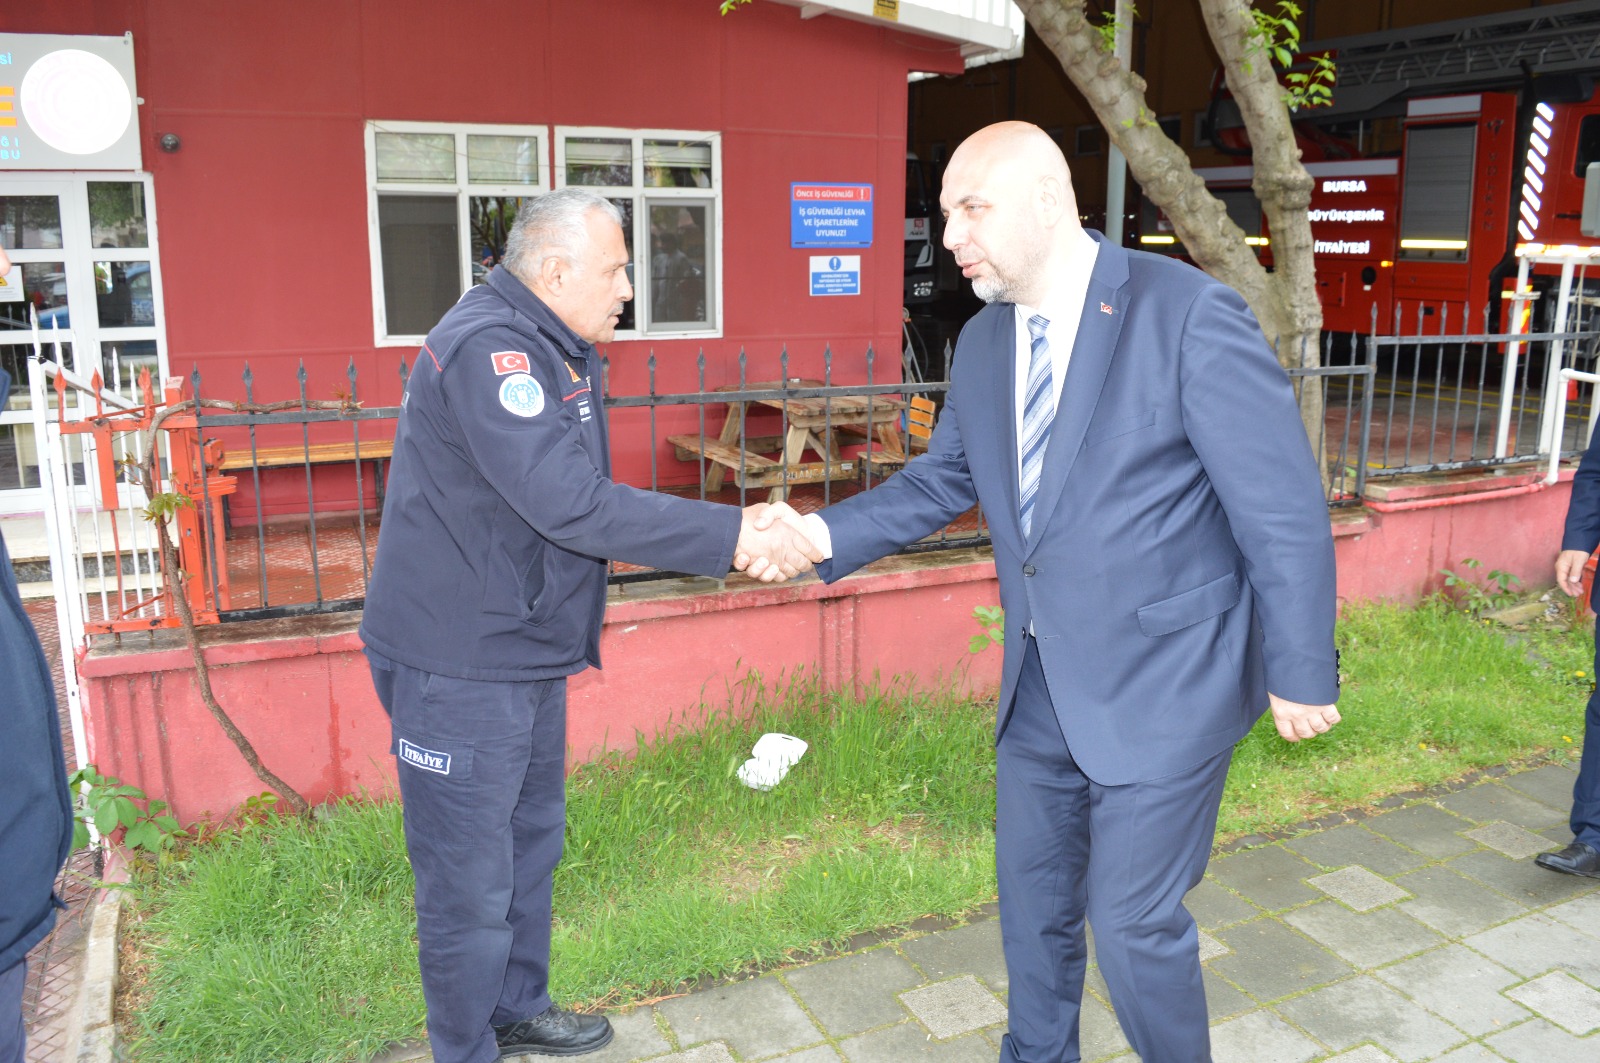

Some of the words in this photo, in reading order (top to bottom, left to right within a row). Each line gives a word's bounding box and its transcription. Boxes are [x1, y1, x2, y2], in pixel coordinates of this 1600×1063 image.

[1322, 181, 1366, 193] BURSA
[796, 188, 813, 198] ÖNCE
[815, 189, 821, 199] İŞ
[822, 189, 853, 198] GÜVENLİĞİ
[799, 207, 806, 217] İŞ
[807, 206, 843, 216] GÜVENLİĞİ
[845, 208, 866, 216] LEVHA
[814, 218, 858, 227] İŞARETLERİNE
[1314, 240, 1370, 254] İTFAİYESİ
[404, 745, 443, 768] İTFAİYE
